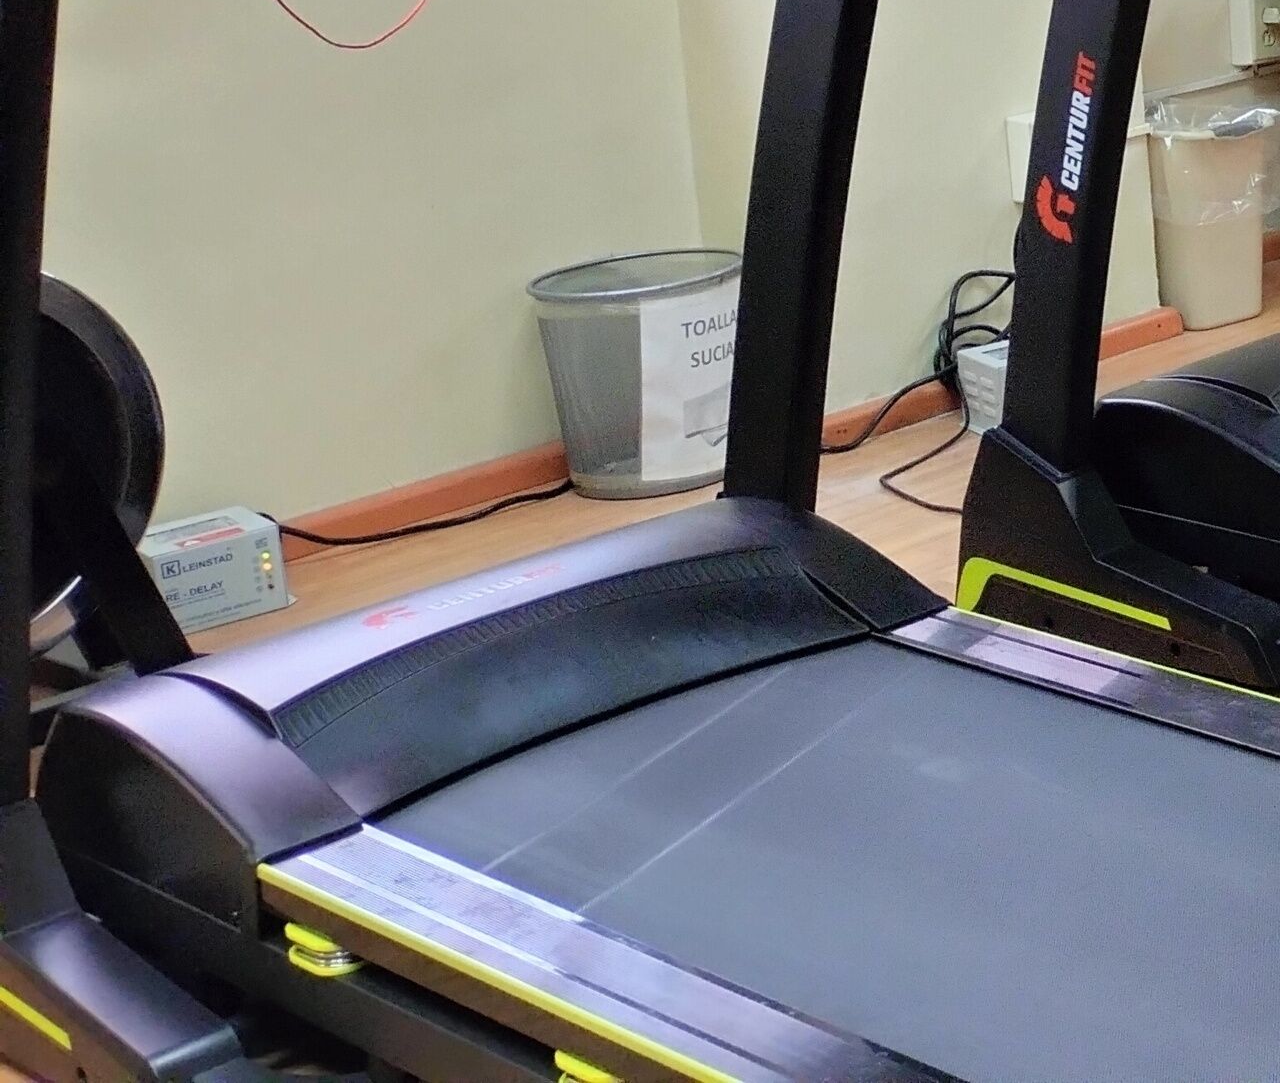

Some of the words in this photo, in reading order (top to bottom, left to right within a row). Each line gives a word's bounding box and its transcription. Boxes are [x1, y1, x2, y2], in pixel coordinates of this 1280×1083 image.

[1060, 50, 1097, 192] CENTURFIT
[681, 309, 738, 339] TOALLA
[691, 343, 735, 368] SUCIA
[189, 580, 224, 597] DELAY
